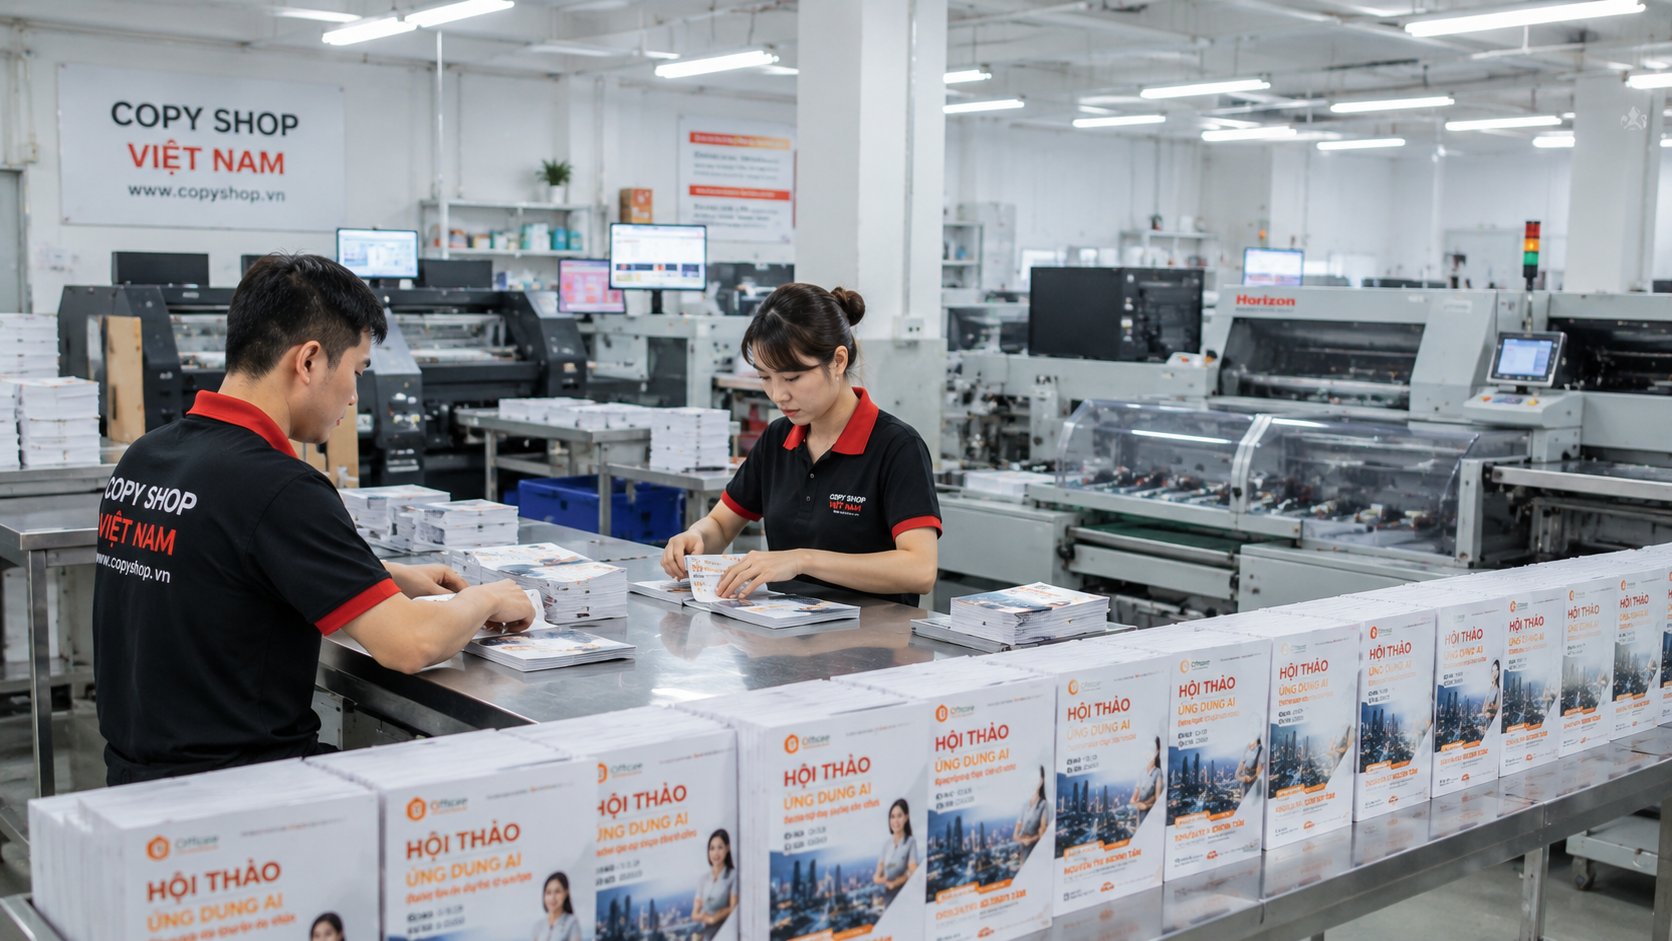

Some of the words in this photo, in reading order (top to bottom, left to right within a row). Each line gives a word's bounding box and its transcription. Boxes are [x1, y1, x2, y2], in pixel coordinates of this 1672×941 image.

[111, 101, 203, 131] COPY
[213, 109, 299, 136] SHOP
[127, 139, 202, 175] VIỆT
[213, 148, 285, 175] NAM
[128, 184, 285, 203] www.copyshop.vn
[1236, 294, 1296, 306] Horizon
[104, 476, 147, 506] COPY
[144, 485, 198, 516] SHOP
[98, 510, 133, 548] VIỆT
[132, 522, 177, 556] NAM
[1279, 662, 1298, 681] HỘI
[1301, 657, 1329, 675] THẢO
[1179, 680, 1200, 700] HỘI
[1204, 674, 1236, 694] THẢO
[1067, 702, 1091, 723] HỘI
[1095, 695, 1131, 716] THẢO
[1227, 697, 1236, 707] AI
[935, 729, 963, 753] HỘI
[967, 722, 1009, 745] THẢO
[1121, 719, 1131, 730] AI
[999, 748, 1010, 760] AI
[784, 763, 816, 789] HỘI
[822, 753, 871, 780] THẢO
[597, 792, 627, 819] HỘI
[633, 782, 687, 810] THẢO
[859, 782, 871, 797] AI
[675, 812, 688, 827] AI
[406, 831, 449, 862] HỘI
[456, 820, 520, 850] THẢO
[504, 852, 522, 869] AI
[147, 871, 197, 905] HỘI
[205, 858, 281, 891] THẢO
[264, 893, 283, 911] AI
